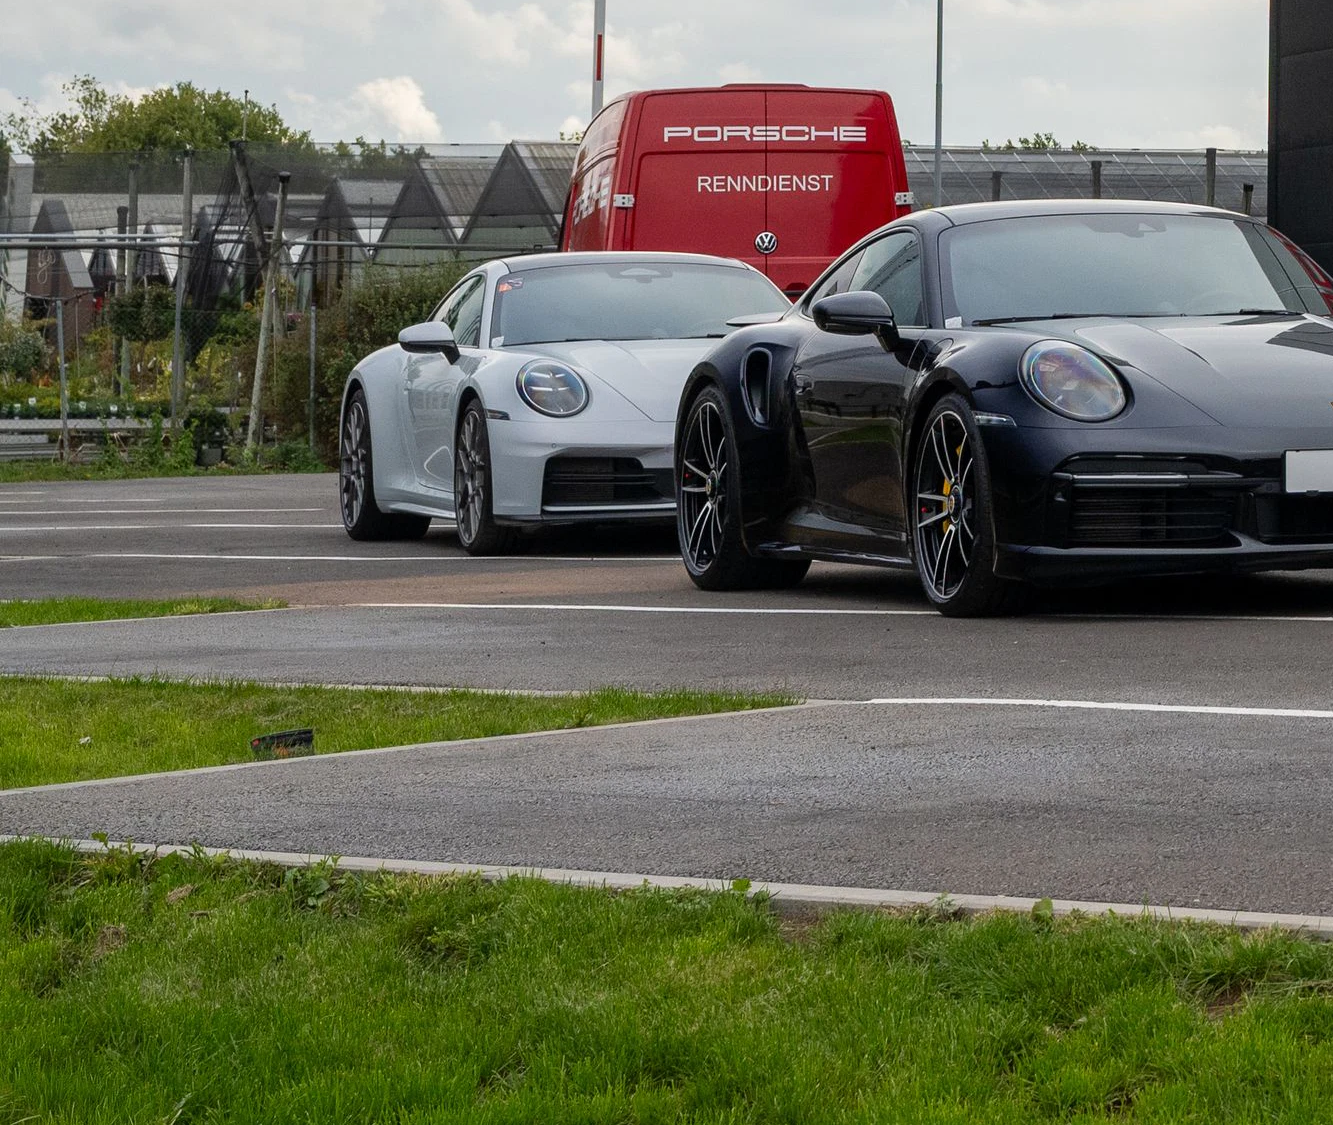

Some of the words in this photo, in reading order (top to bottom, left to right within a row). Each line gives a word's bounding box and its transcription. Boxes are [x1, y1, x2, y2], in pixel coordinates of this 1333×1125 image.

[663, 125, 867, 142] PORSCHE
[697, 174, 834, 192] RENNDIENST
[754, 231, 778, 254] VW
